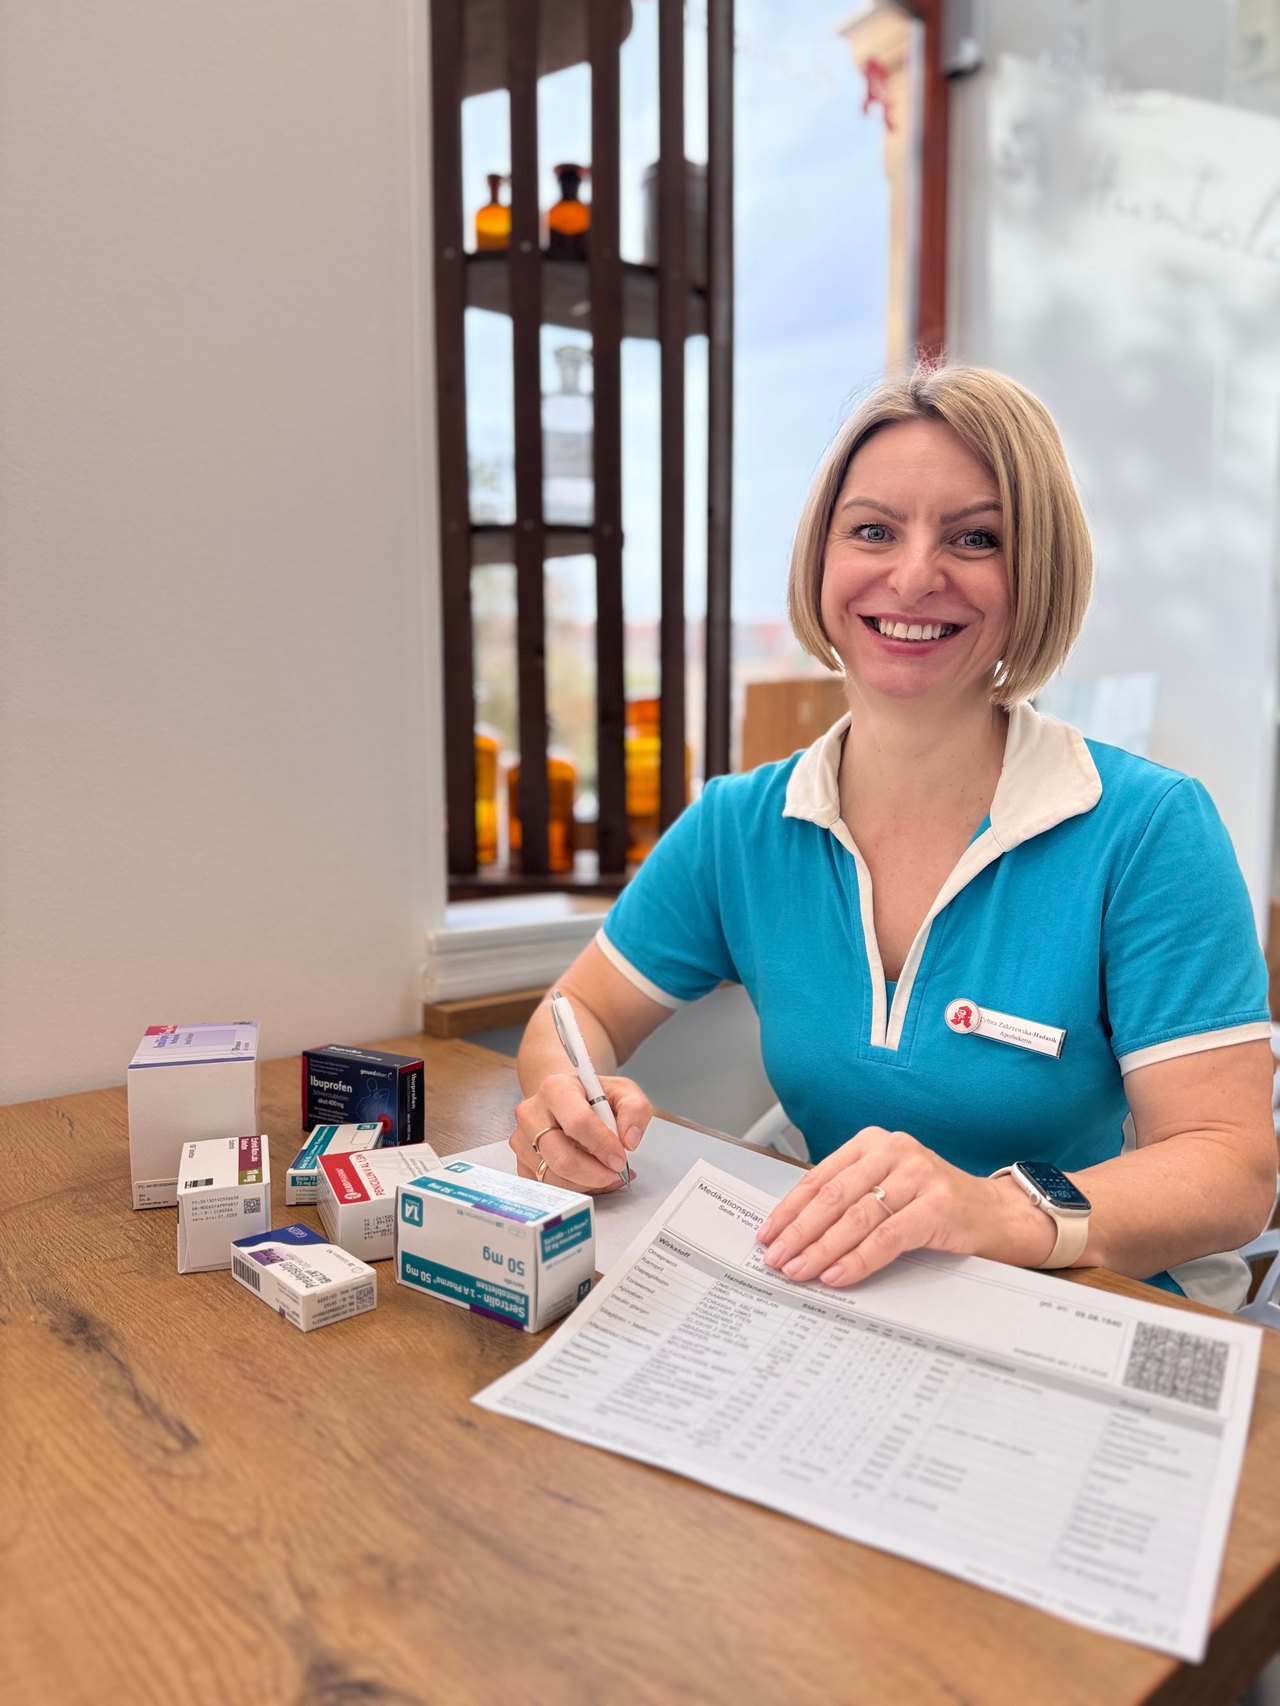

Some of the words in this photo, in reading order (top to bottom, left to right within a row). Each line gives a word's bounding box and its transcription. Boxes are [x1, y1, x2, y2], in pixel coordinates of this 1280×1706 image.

[1000, 1031, 1032, 1045] Apothekerin
[310, 1075, 353, 1094] Ibuprofen
[243, 1175, 257, 1183] mg
[428, 1182, 442, 1192] mg
[442, 1186, 452, 1195] 50
[404, 1203, 421, 1221] 1A
[697, 1182, 764, 1225] Medikationsplan
[718, 1204, 735, 1219] Seite
[741, 1216, 753, 1228] von
[753, 1223, 760, 1232] 2
[482, 1245, 505, 1266] mg
[277, 1260, 319, 1290] Prednisolon
[405, 1262, 420, 1278] mg
[507, 1257, 526, 1277] 50
[420, 1270, 433, 1285] 50
[625, 1277, 655, 1293] Torasemid
[640, 1257, 664, 1271] Ramipril
[708, 1291, 736, 1304] RAMIPRIL
[647, 1249, 678, 1265] Omeprazol
[715, 1281, 755, 1298] OMEPRAZOL
[757, 1297, 778, 1309] MYLAN
[658, 1237, 691, 1259] Wirkstoff
[723, 1271, 774, 1297] Handelsname
[802, 1301, 827, 1315] Stärke
[834, 1313, 857, 1325] Form
[461, 1285, 471, 1297] A
[469, 1286, 476, 1299] 1
[476, 1280, 526, 1306] Filmtabletten
[618, 1285, 644, 1299] Apixaban
[712, 1285, 729, 1295] 20MG
[483, 1293, 526, 1319] Sertralin
[611, 1292, 629, 1305] Insulin
[629, 1303, 649, 1316] glargin
[699, 1302, 751, 1322] FILMTABLETTEN
